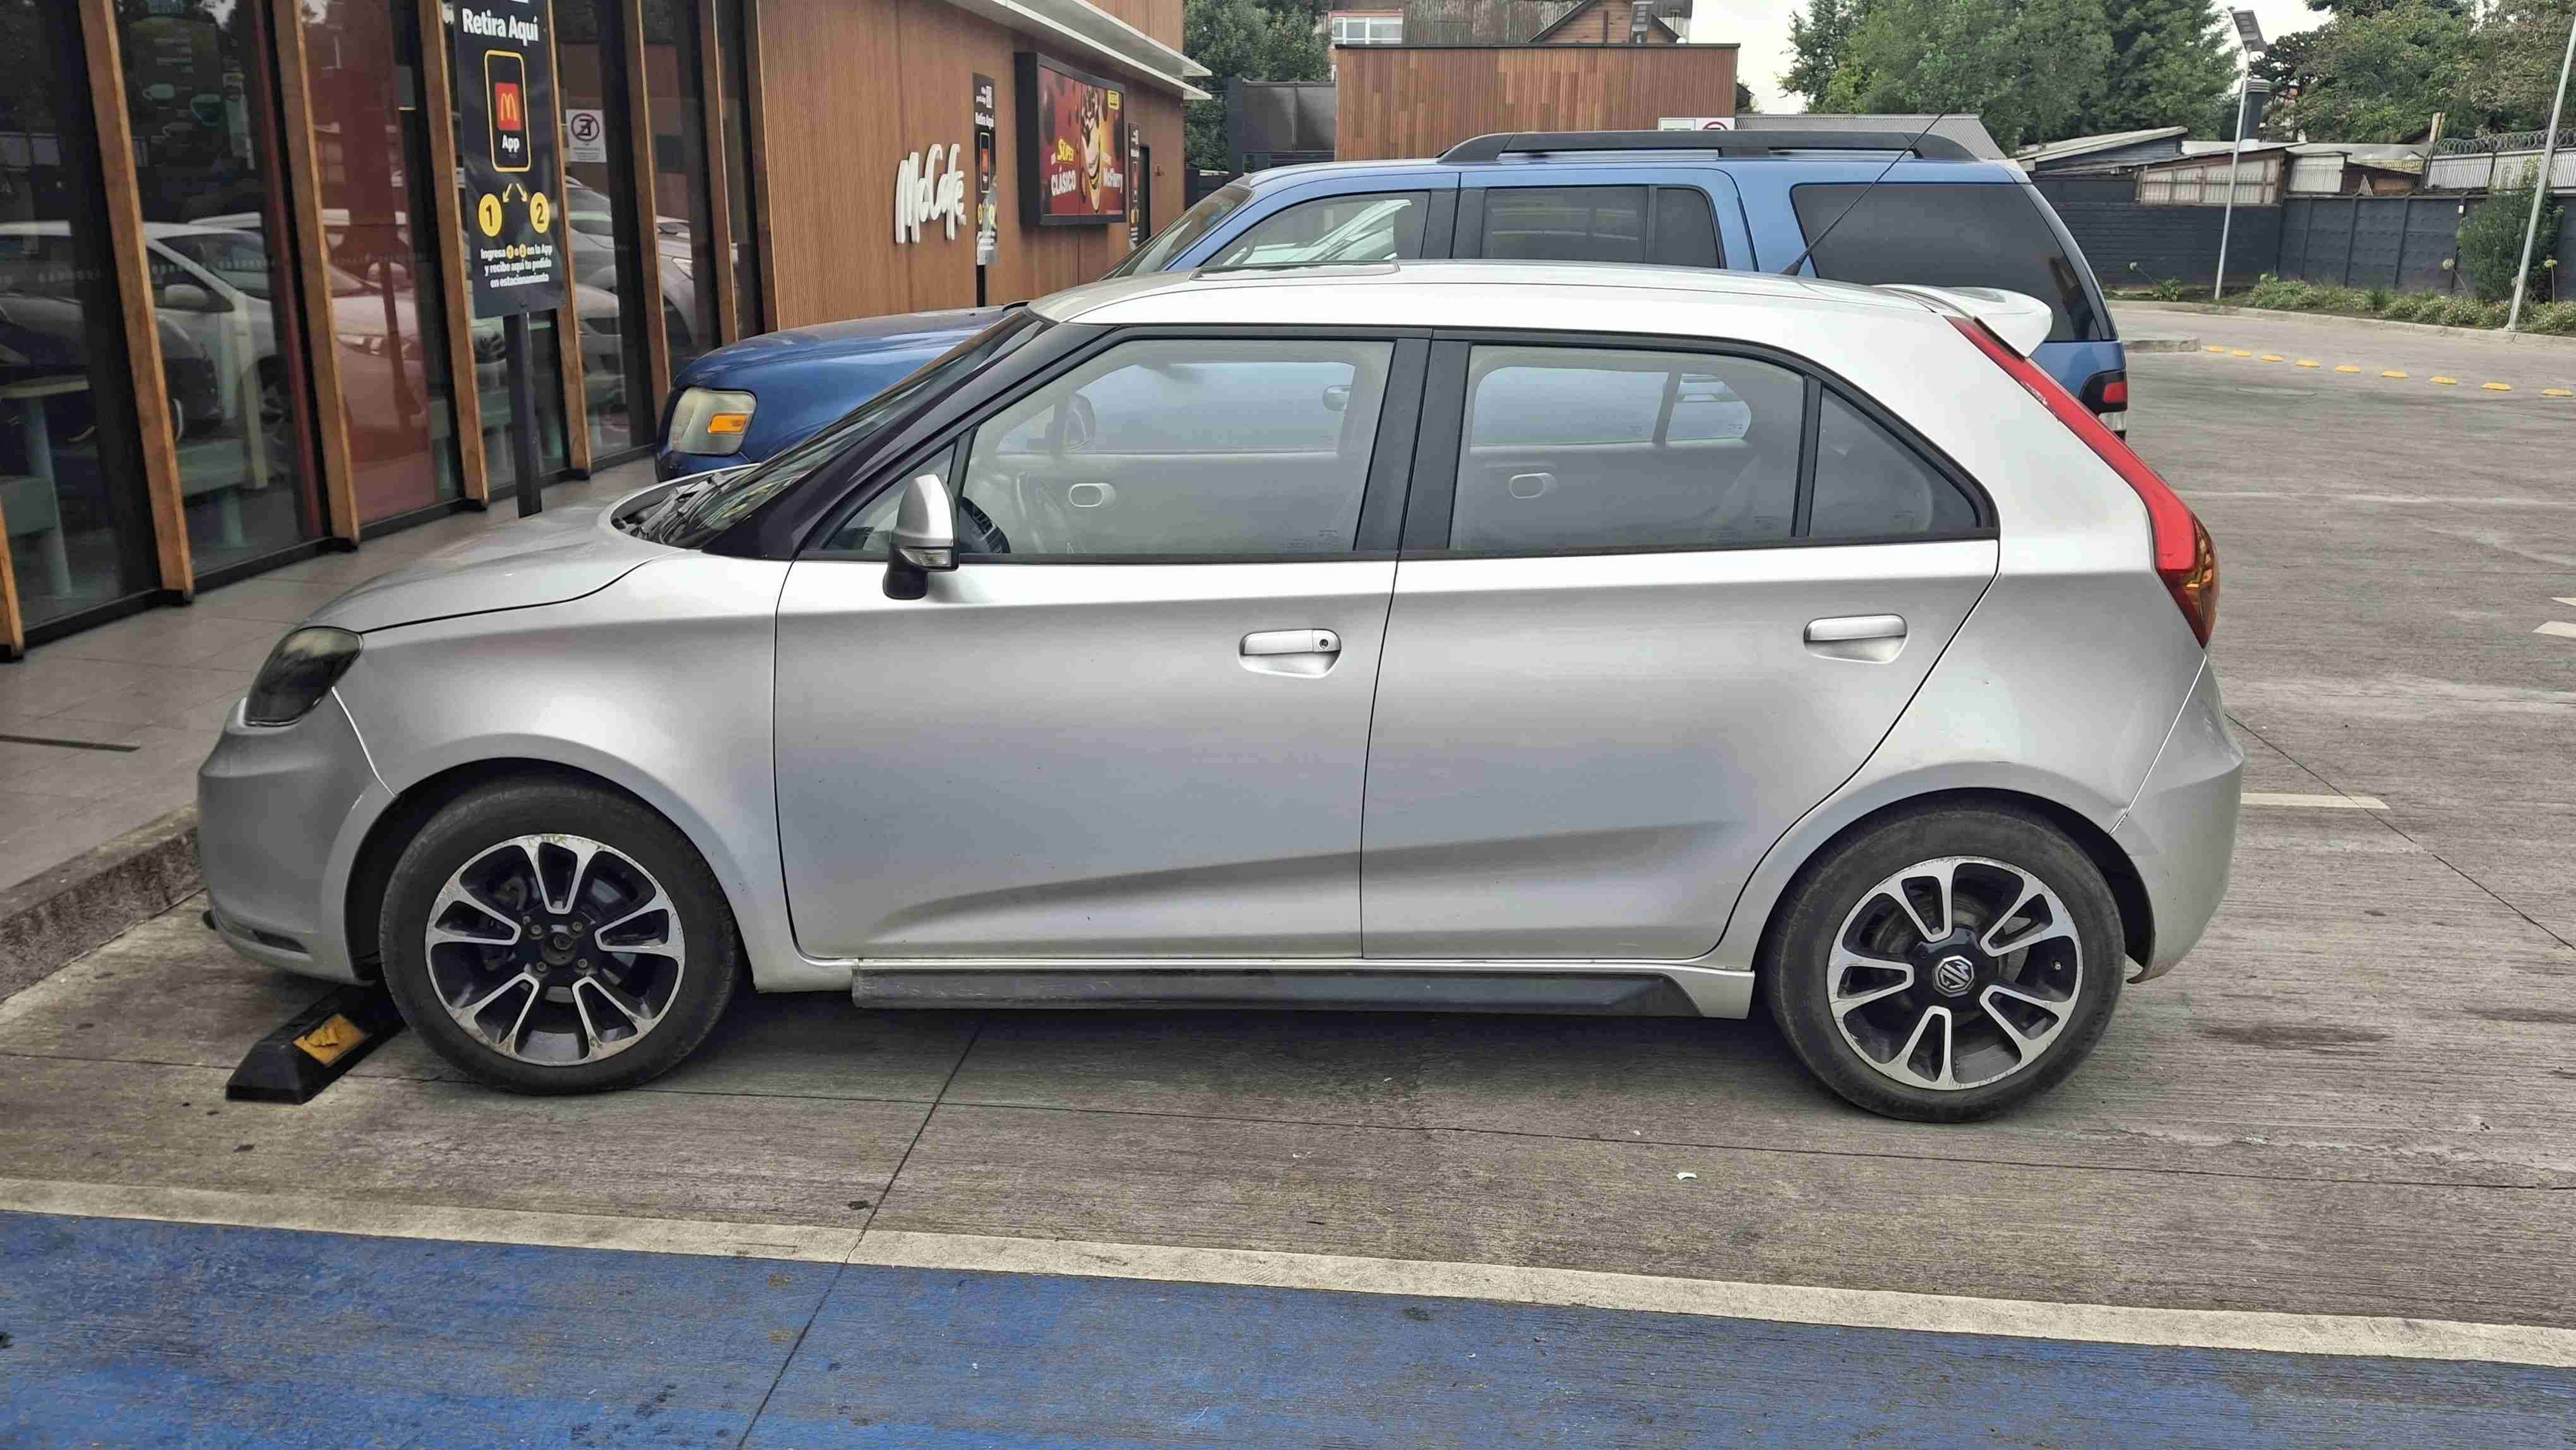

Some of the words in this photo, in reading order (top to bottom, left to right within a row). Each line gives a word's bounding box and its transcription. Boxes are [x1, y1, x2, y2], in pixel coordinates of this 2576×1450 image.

[462, 8, 506, 37] Retira
[508, 15, 539, 47] Aquí
[502, 134, 520, 153] App
[1051, 165, 1076, 196] CLÁSICO
[486, 205, 492, 227] 1
[536, 202, 544, 224] 2
[480, 248, 506, 261] Ingresa
[527, 246, 535, 255] en
[541, 243, 552, 256] App
[484, 265, 489, 277] y
[490, 261, 510, 273] recibe
[511, 259, 525, 273] aquí
[525, 260, 532, 270] tu
[532, 257, 552, 272] pedido
[490, 279, 499, 288] en
[499, 272, 549, 287] estacionamiento
